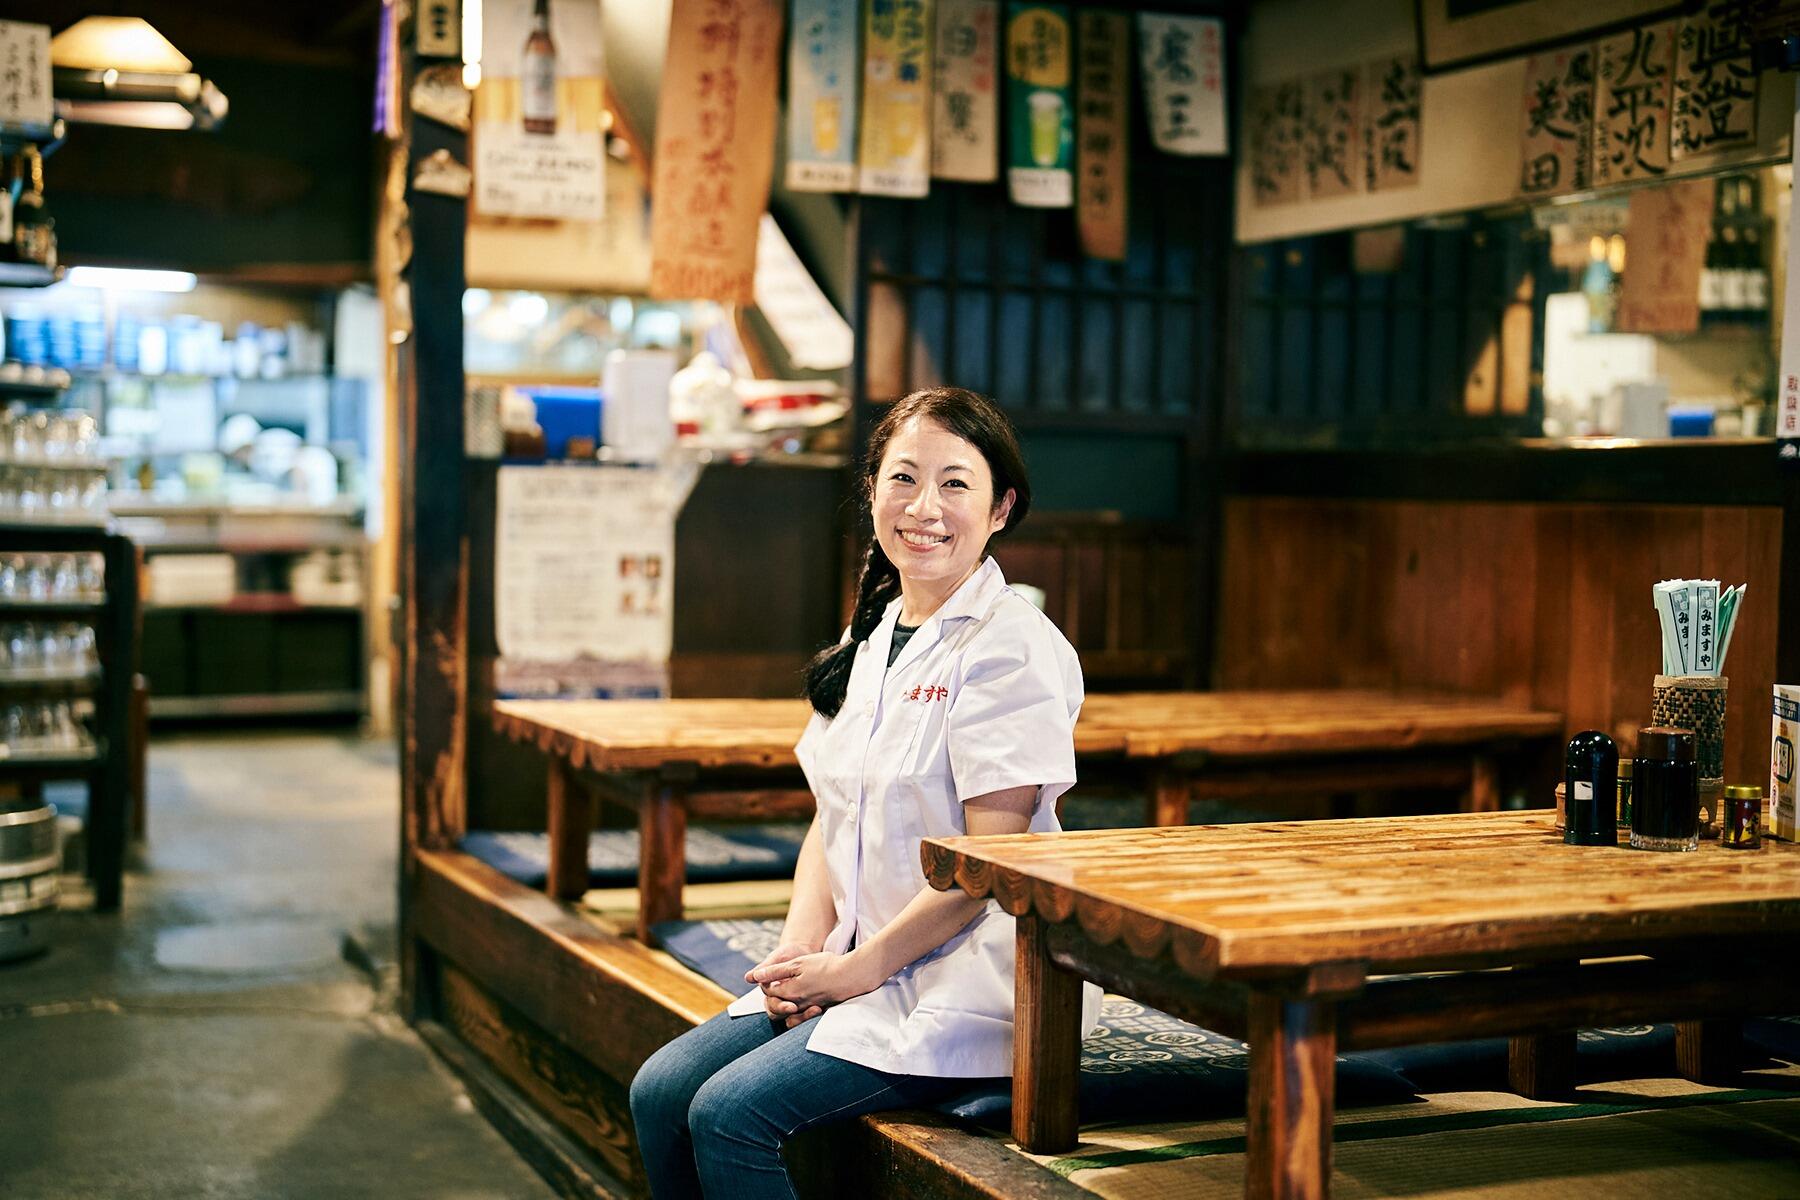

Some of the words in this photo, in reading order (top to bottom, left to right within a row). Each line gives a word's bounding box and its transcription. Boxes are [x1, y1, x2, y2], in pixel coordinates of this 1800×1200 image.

[1610, 28, 1667, 174] 九平次
[1678, 612, 1689, 650] みま
[1700, 609, 1713, 667] みますや
[902, 685, 948, 703] ますや
